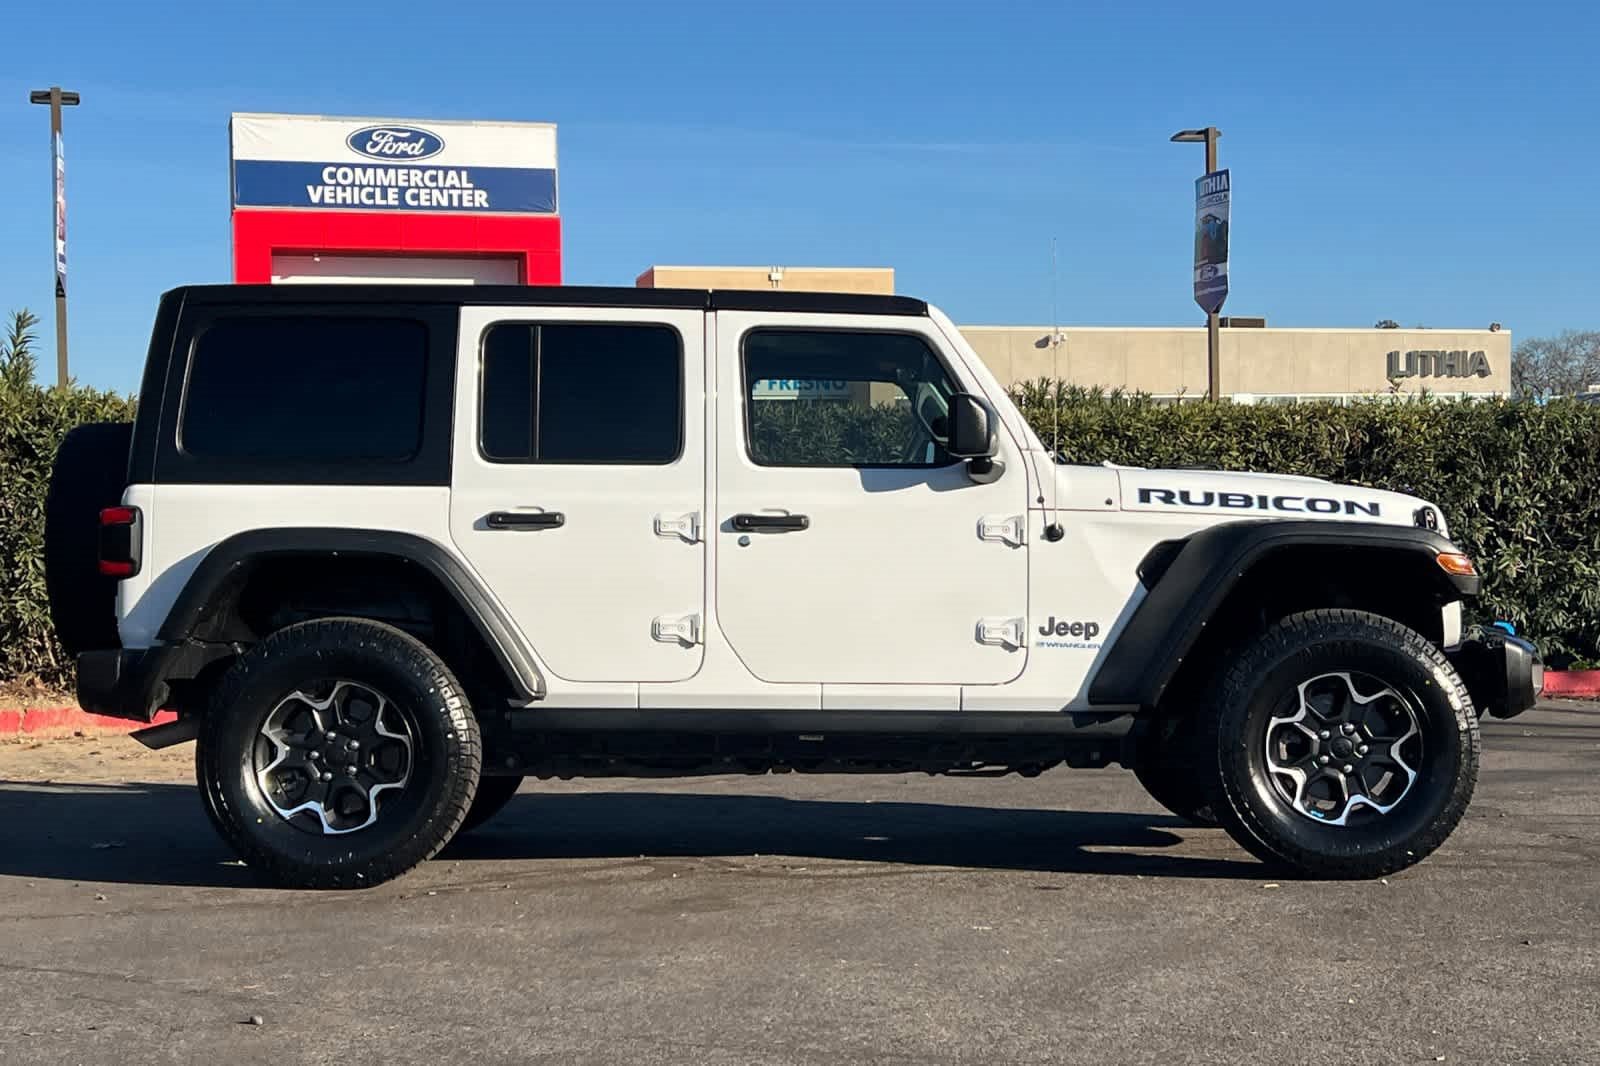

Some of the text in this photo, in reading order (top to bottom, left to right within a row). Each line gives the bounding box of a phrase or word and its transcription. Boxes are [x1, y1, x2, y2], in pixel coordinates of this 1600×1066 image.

[365, 128, 425, 156] Ford
[322, 166, 474, 189] COMMERCIAL
[307, 184, 489, 208] VEHICLE CENTER
[1387, 350, 1492, 378] LITHIA
[767, 379, 846, 391] FRESNO
[1137, 487, 1381, 516] RUBICON
[1038, 616, 1100, 641] Jeep
